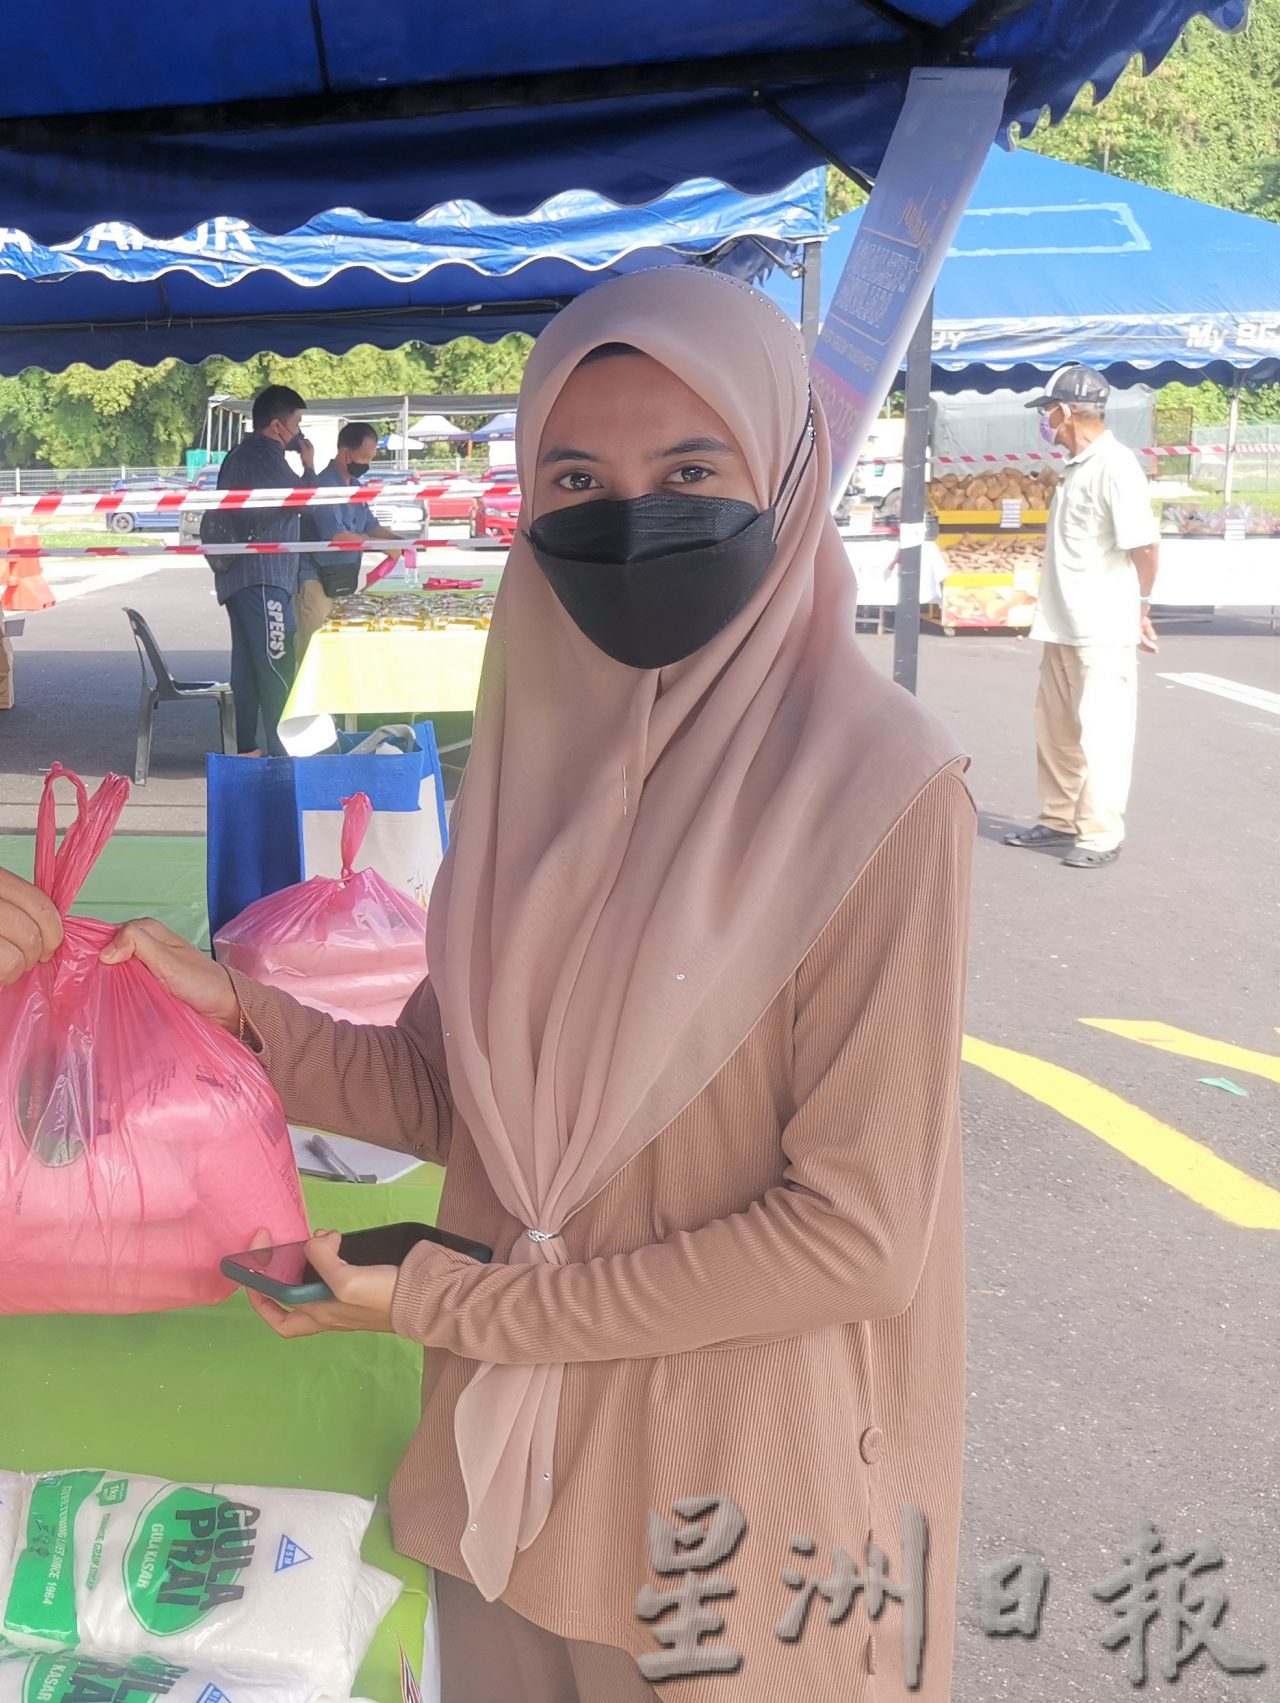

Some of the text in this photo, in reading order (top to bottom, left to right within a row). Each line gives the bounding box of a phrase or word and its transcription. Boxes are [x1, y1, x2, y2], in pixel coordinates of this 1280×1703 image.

[267, 600, 286, 651] SPECS
[47, 1553, 65, 1581] SINCE
[136, 1522, 165, 1589] GULA KASAR
[156, 1506, 218, 1607] PRAI
[198, 1501, 261, 1612] GULA
[284, 1542, 298, 1565] MSM
[42, 1581, 58, 1606] 1964
[35, 1663, 67, 1702] KASAR
